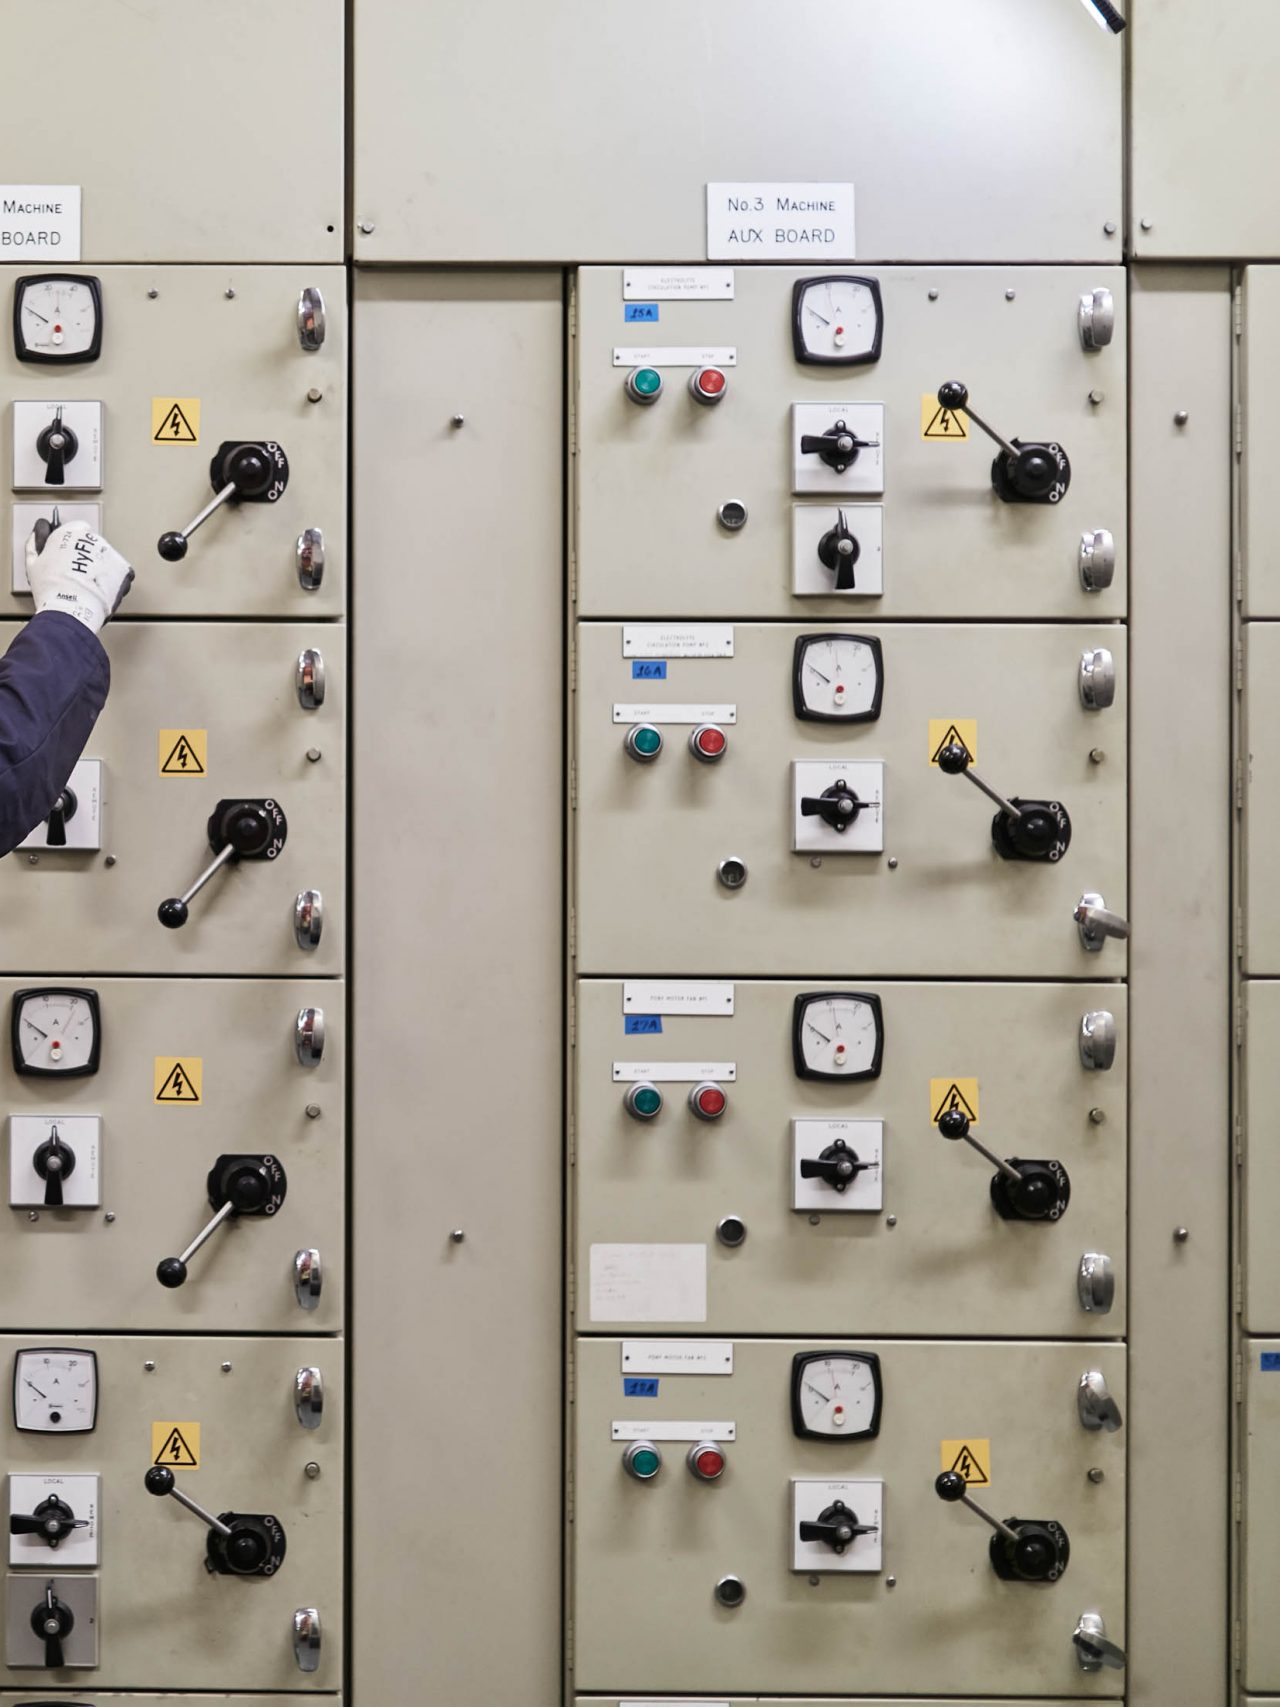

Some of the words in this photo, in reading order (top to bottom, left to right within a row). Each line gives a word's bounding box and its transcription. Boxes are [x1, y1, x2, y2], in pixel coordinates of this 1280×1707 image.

[728, 197, 764, 211] No.3
[1, 231, 61, 245] BOARD
[728, 228, 763, 243] AUX
[775, 228, 835, 243] BOARD
[268, 442, 284, 468] OFF
[1049, 443, 1066, 470] OFF
[268, 481, 284, 499] ON
[1049, 483, 1065, 501] ON
[56, 592, 78, 602] Ansell
[265, 800, 282, 825] OFF
[1049, 802, 1066, 828] OFF
[267, 839, 283, 857] ON
[1050, 841, 1065, 860] ON
[264, 1156, 281, 1181] OFF
[1049, 1161, 1066, 1187] OFF
[266, 1195, 281, 1213] ON
[1050, 1200, 1066, 1218] ON
